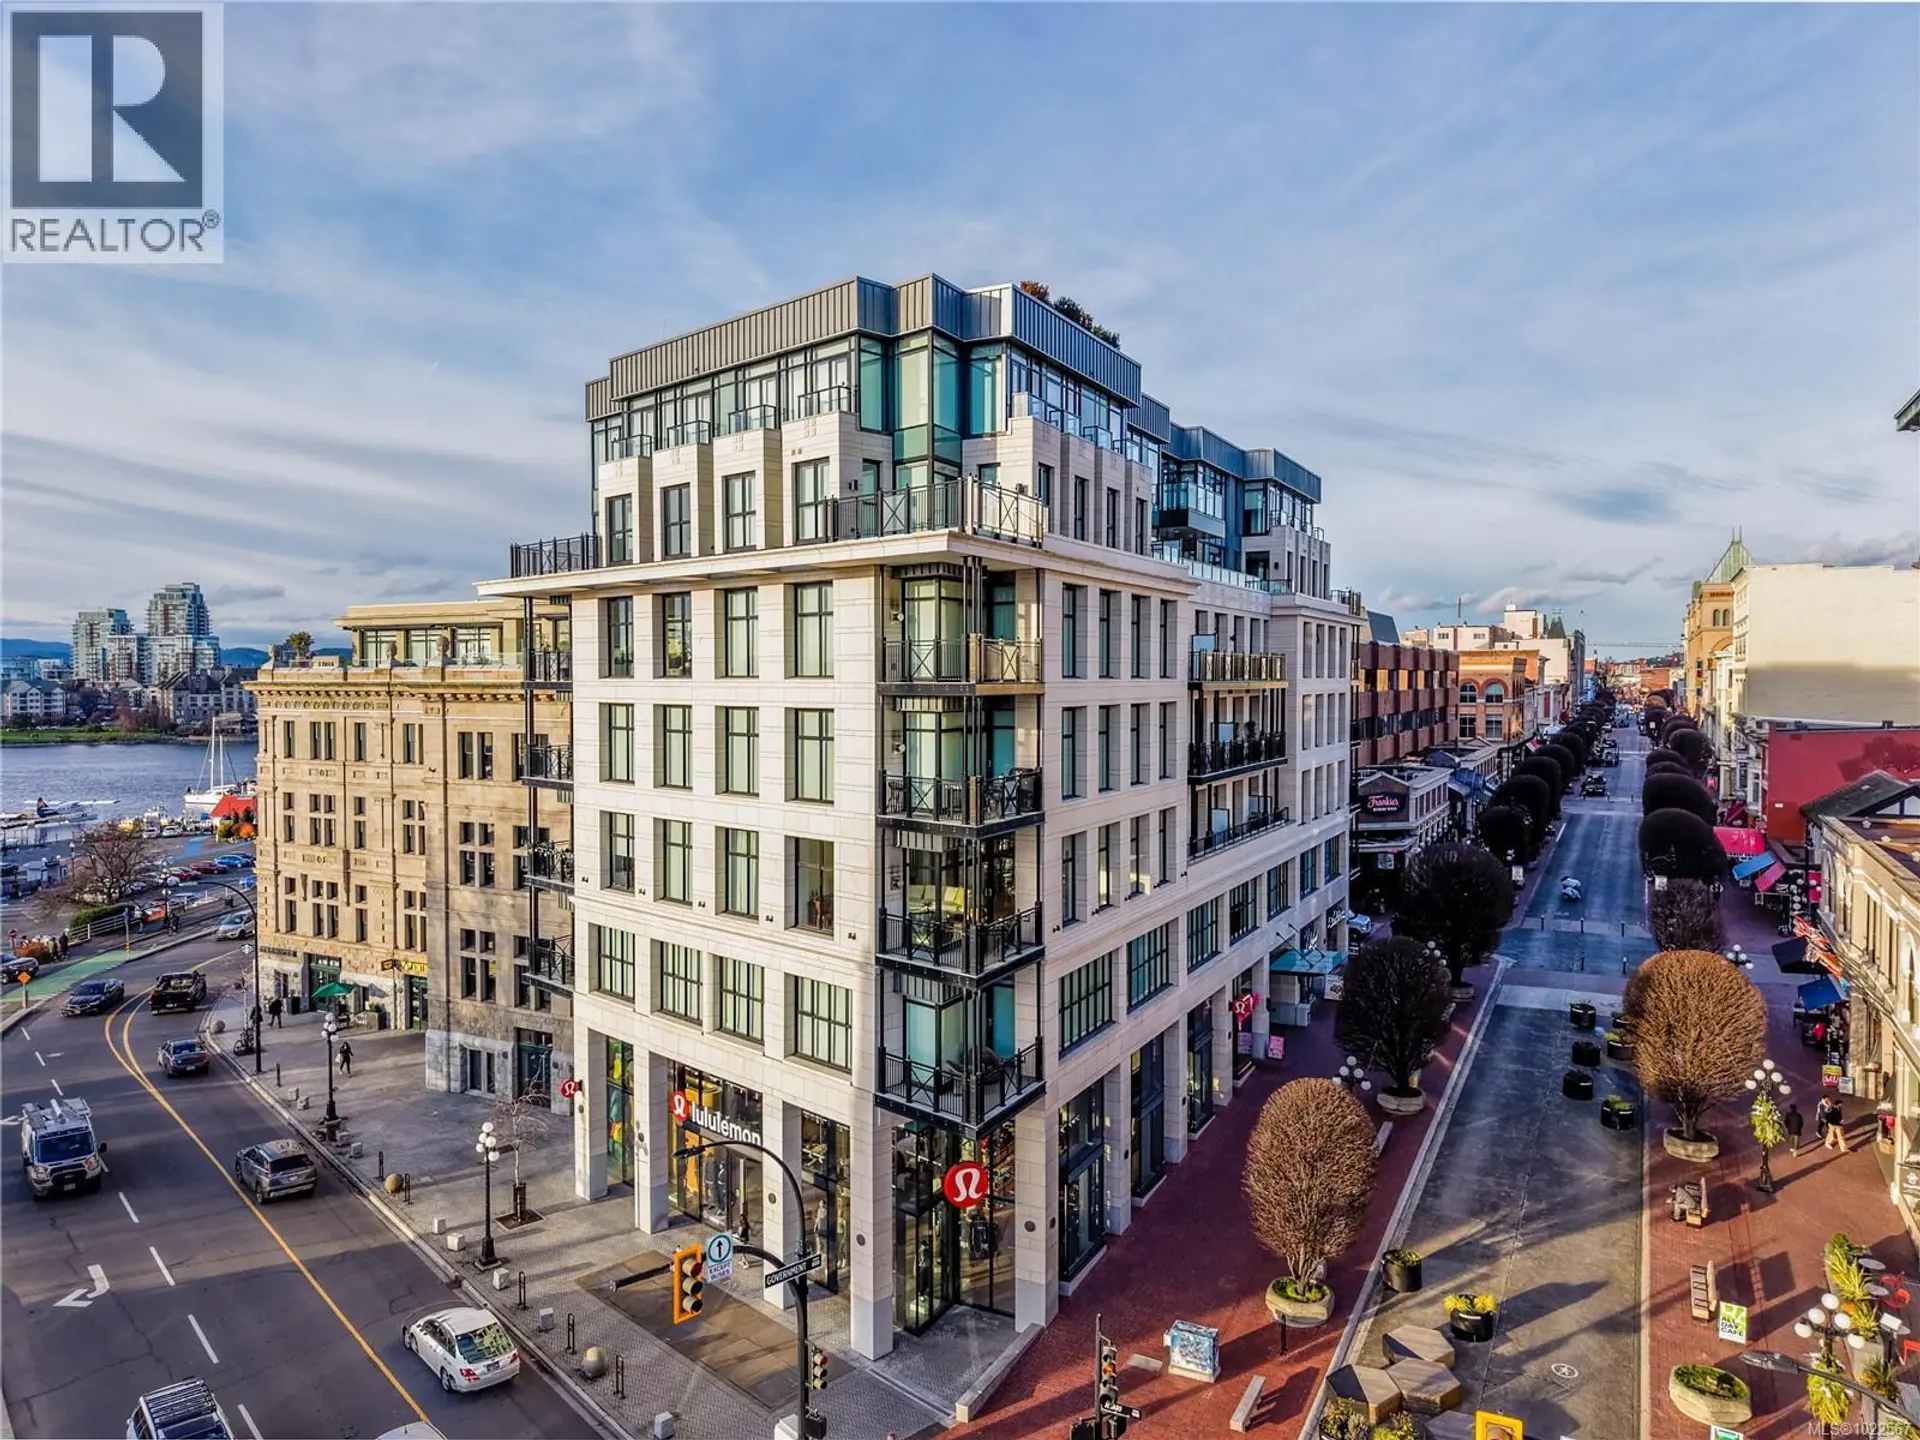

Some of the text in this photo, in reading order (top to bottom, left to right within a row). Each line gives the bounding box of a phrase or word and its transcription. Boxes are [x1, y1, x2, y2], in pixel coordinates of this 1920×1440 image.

[692, 1101, 761, 1146] lululemon
[709, 1262, 731, 1274] EXCEPT
[710, 1269, 731, 1280] BUSES
[766, 1262, 807, 1286] GOVERNMENT
